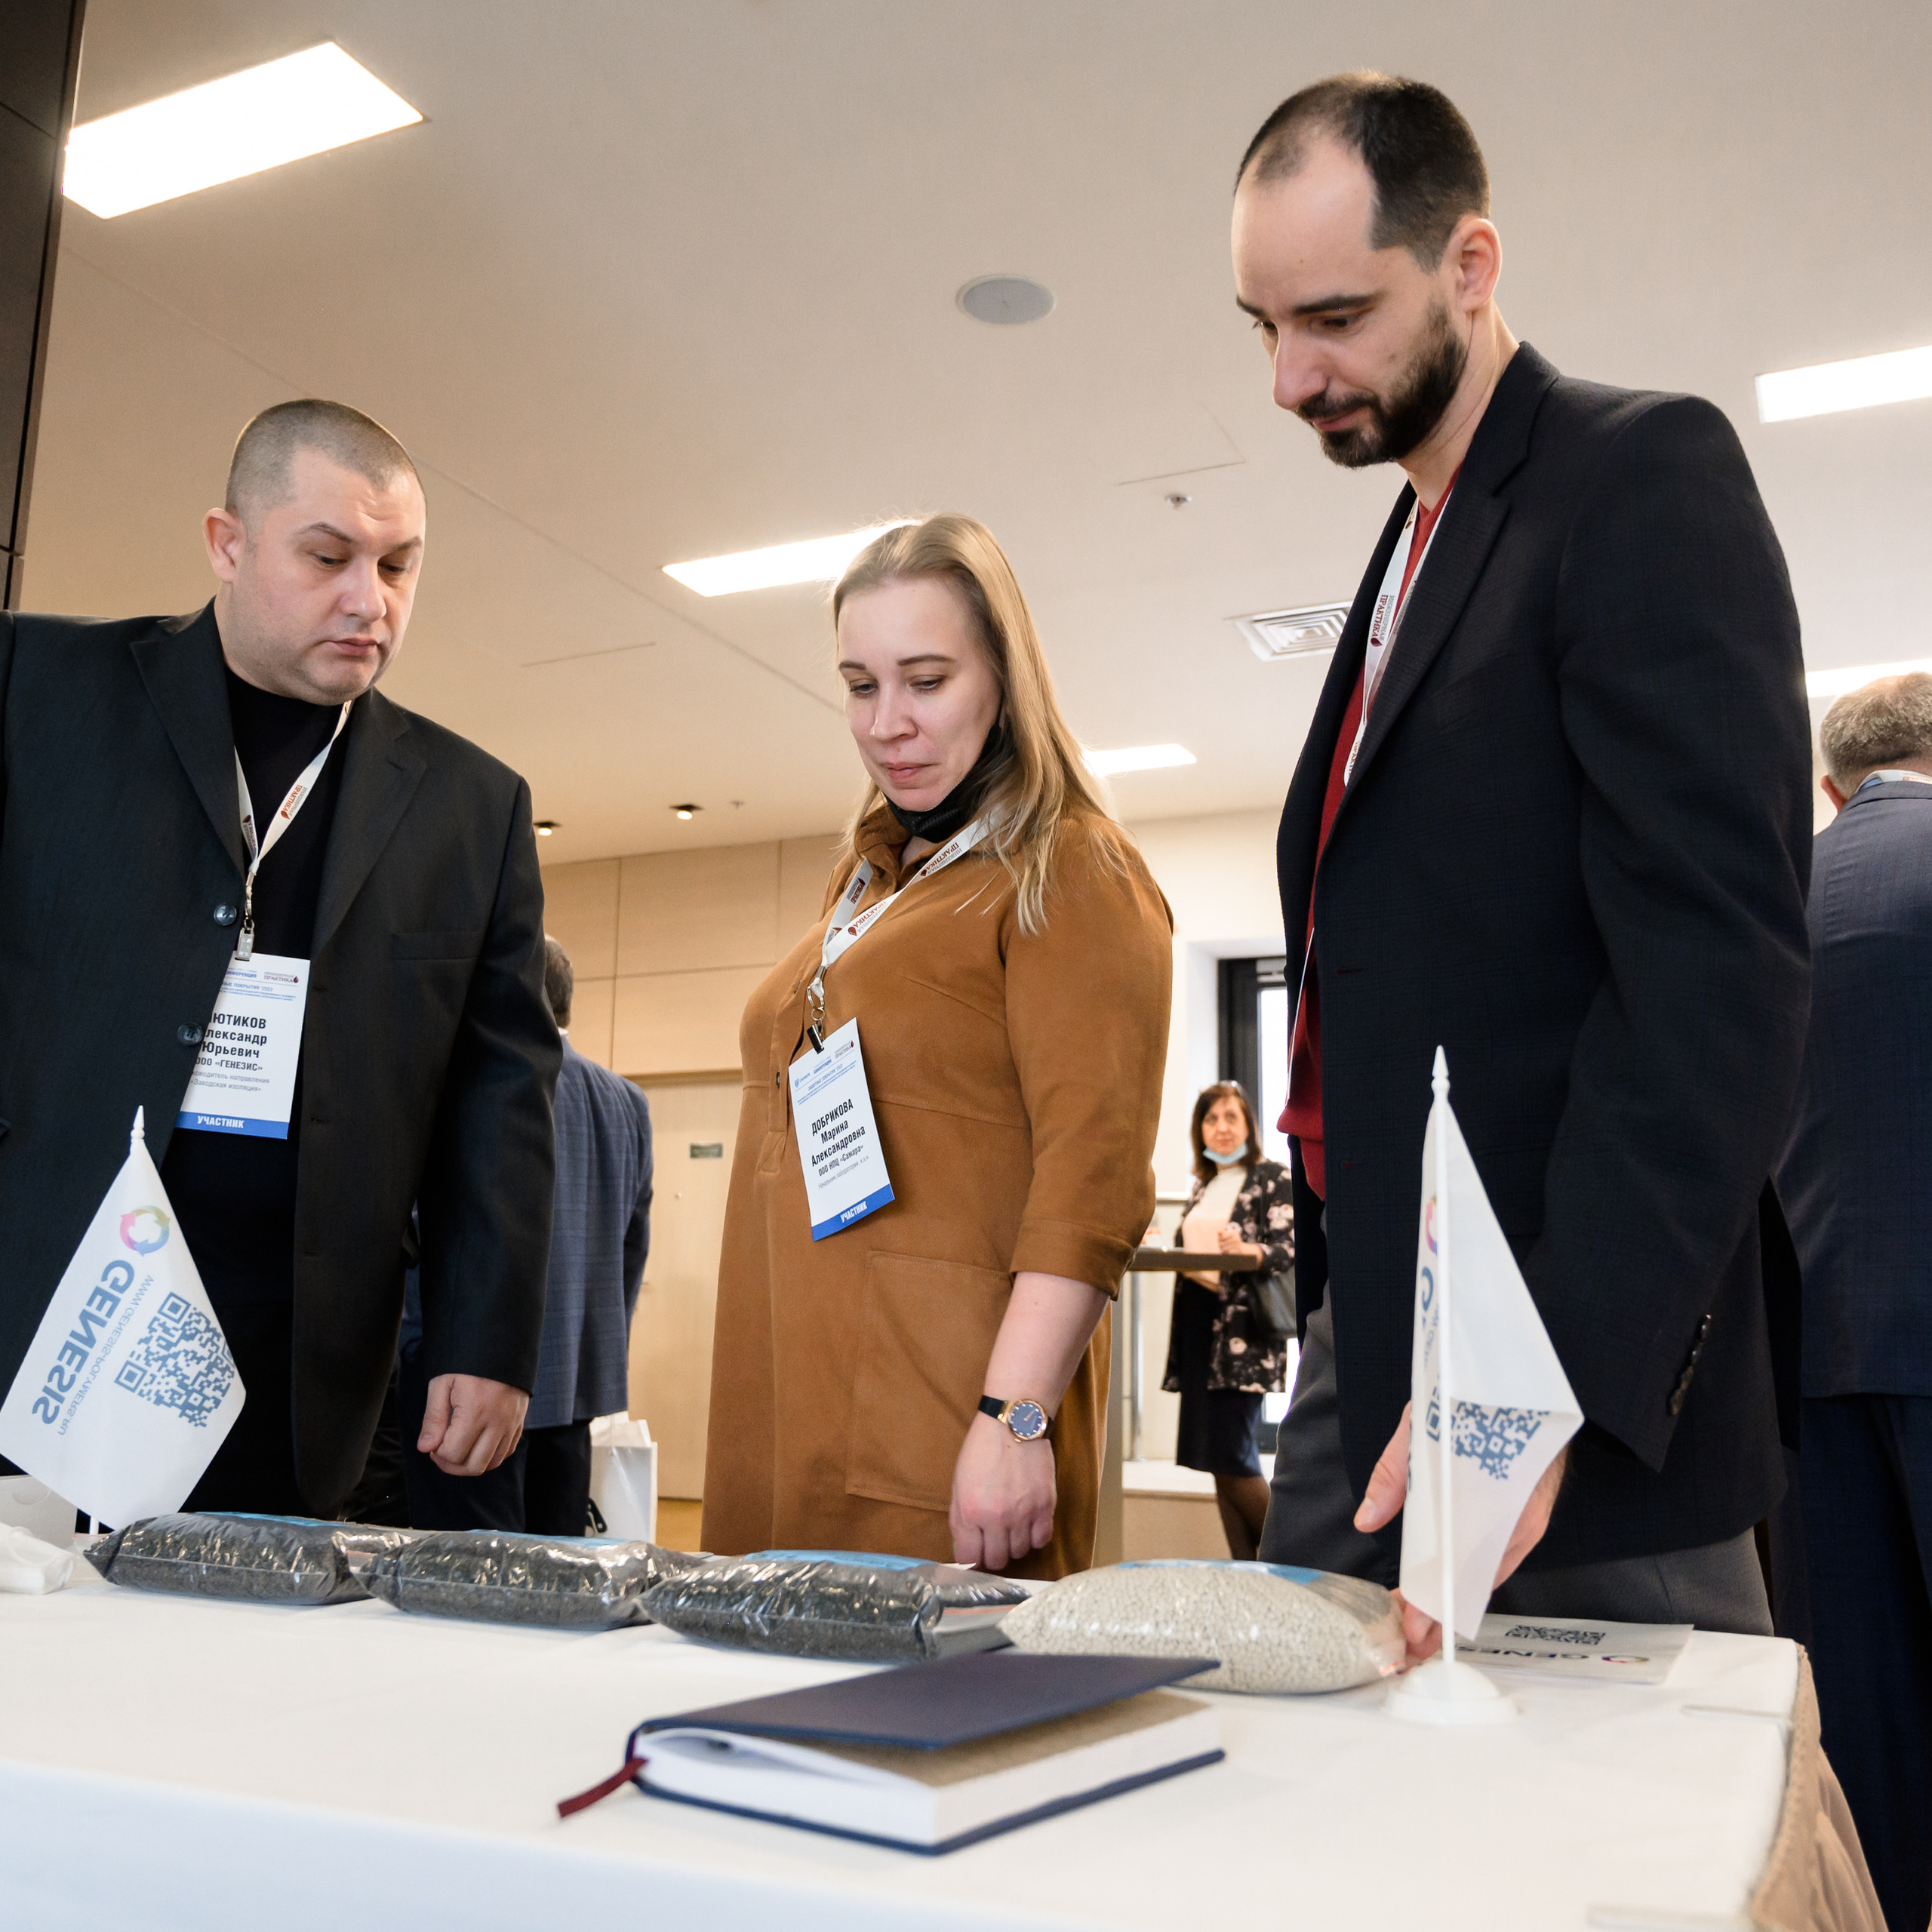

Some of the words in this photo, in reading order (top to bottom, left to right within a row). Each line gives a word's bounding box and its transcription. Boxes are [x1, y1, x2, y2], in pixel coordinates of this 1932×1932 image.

[1372, 595, 1388, 637] ПРАКТИКА
[1380, 595, 1395, 641] ИНЖЕНЕРНАЯ
[283, 784, 303, 811] ПРАКТИКА
[925, 842, 959, 870] ПРАКТИКА
[851, 884, 865, 905] ПРАКТИКА
[854, 901, 887, 928] ПРАКТИКА
[213, 1012, 266, 1029] ЮТИКОВ
[205, 1029, 267, 1046] лександр
[202, 1041, 260, 1058] Юрьевич
[215, 1060, 263, 1071] «ГЕНЕЗИС»
[229, 1075, 270, 1084] направления
[197, 1115, 245, 1128] УЧАСТНИК
[811, 1098, 854, 1136] ДОБРИКОВА
[820, 1120, 848, 1143] Марина
[811, 1126, 866, 1167] Александровна
[818, 1164, 829, 1176] ООО
[840, 1145, 864, 1161] «Самара»
[840, 1201, 868, 1223] УЧАСТНИК
[1454, 1643, 1590, 1660] GENES
